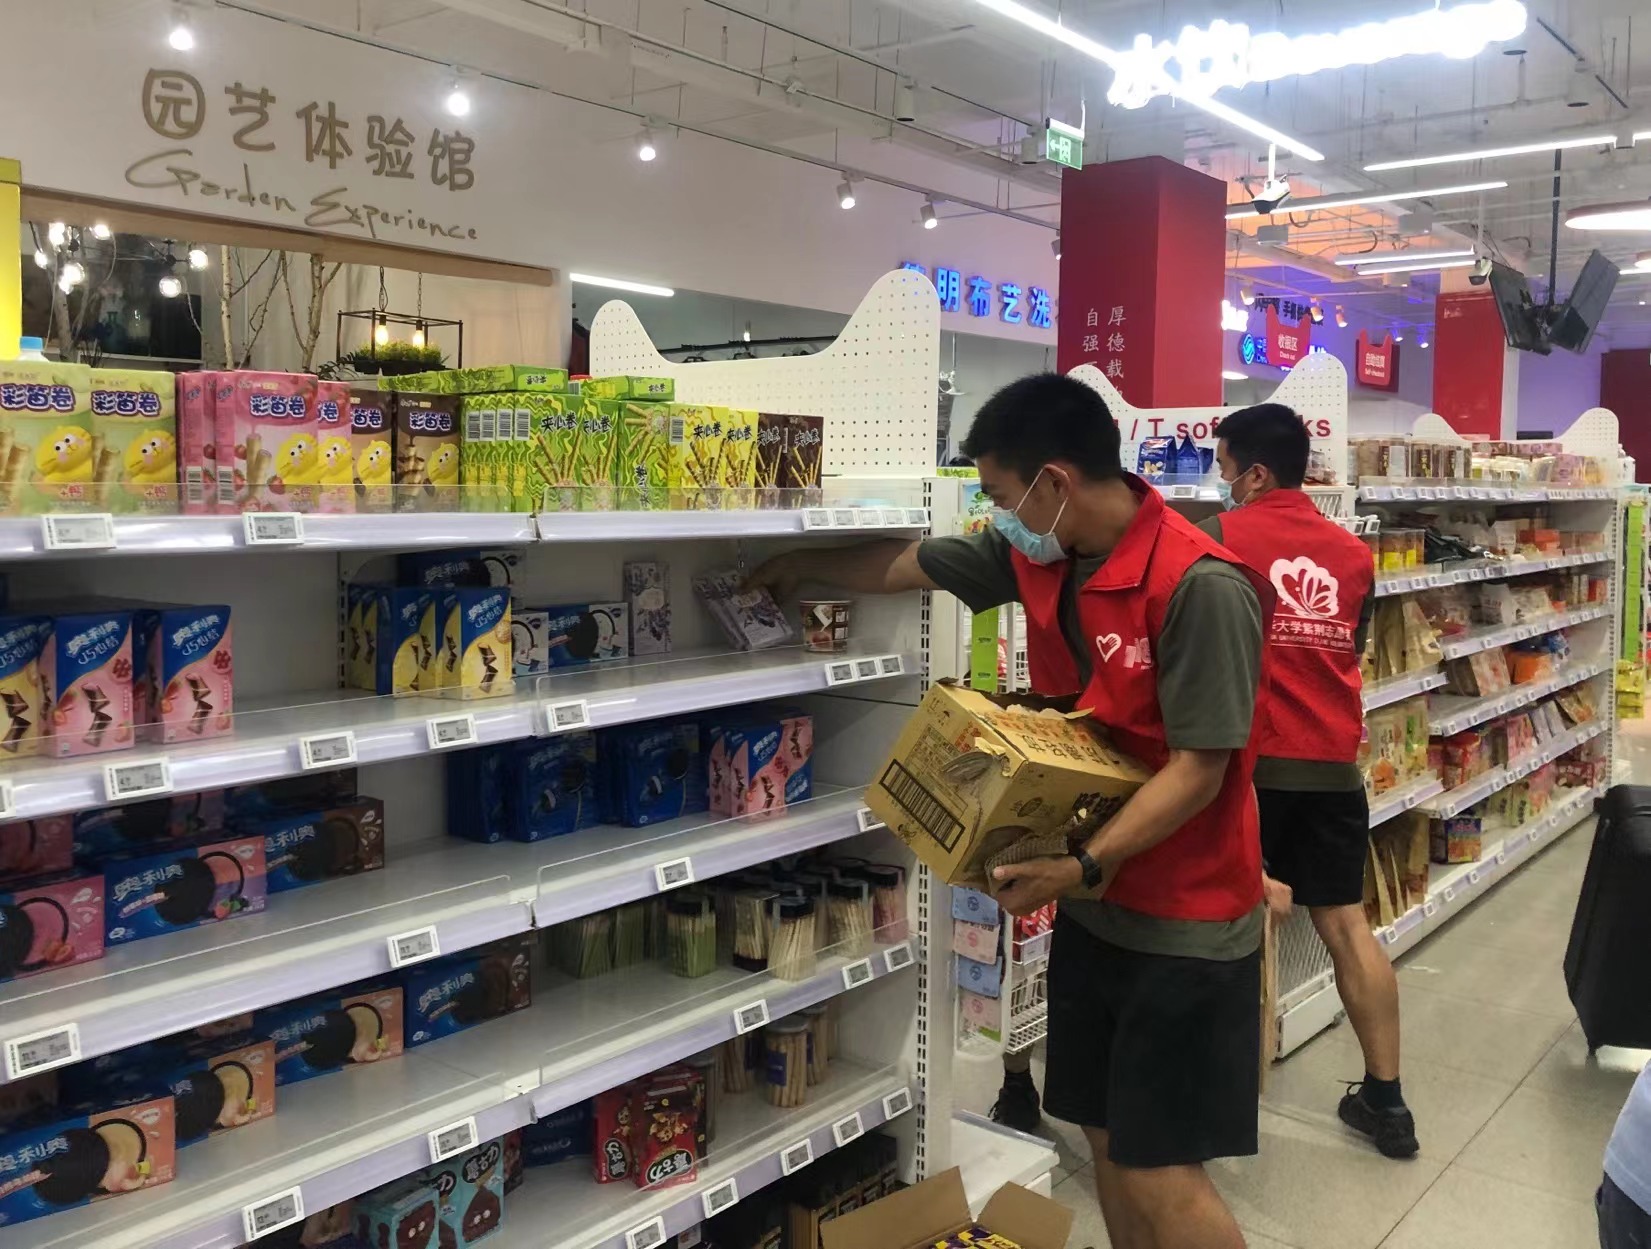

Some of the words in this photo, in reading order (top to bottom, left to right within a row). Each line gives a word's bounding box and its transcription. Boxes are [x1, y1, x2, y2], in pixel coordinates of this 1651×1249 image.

[143, 68, 476, 191] 园艺体验馆
[125, 149, 296, 211] Garden
[304, 187, 479, 240] Experience
[903, 263, 1052, 329] 明布艺洗
[1082, 307, 1099, 364] 自强
[1106, 305, 1127, 396] 厚德载
[351, 408, 383, 428] 笛卷
[112, 864, 185, 902] 奥利奥
[418, 973, 475, 1013] 奥利奥
